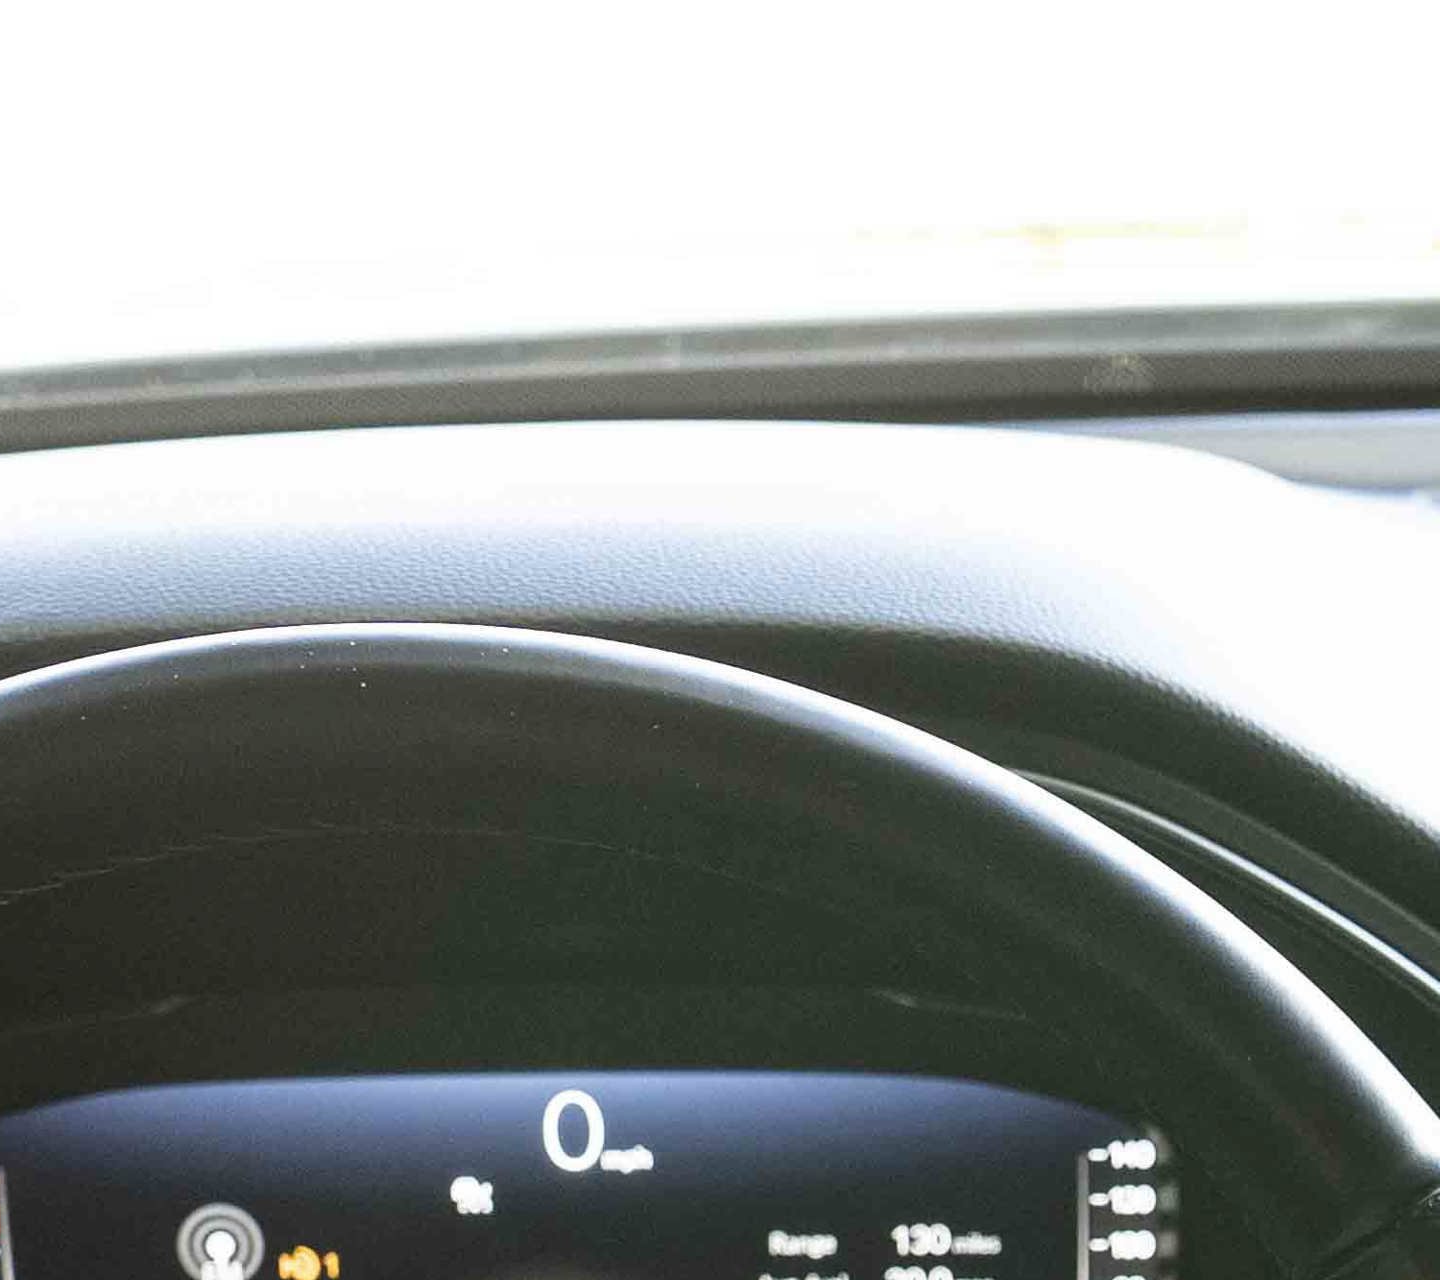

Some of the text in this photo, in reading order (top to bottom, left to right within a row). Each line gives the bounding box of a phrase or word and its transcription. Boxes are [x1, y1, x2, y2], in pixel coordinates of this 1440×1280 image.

[542, 1089, 606, 1172] 0
[768, 1230, 839, 1259] Range
[891, 1223, 952, 1256] 130
